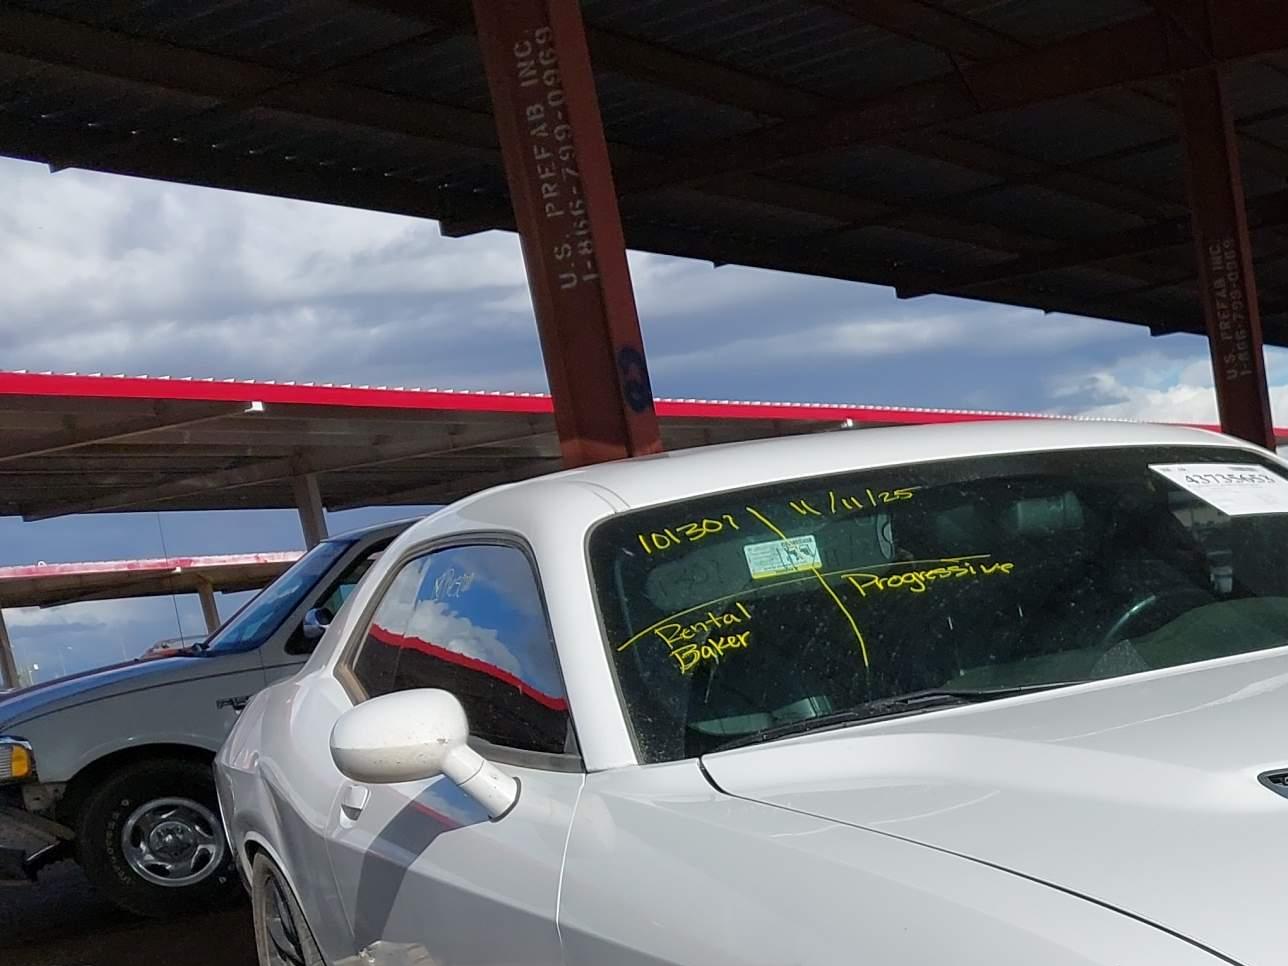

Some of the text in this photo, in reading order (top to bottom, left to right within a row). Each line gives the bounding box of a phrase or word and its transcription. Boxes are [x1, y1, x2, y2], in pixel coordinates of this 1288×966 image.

[525, 104, 564, 218] PREFAB
[552, 233, 578, 290] U.S.
[840, 562, 1016, 598] Progressive
[653, 602, 752, 650] Rental
[669, 630, 751, 675] Baker
